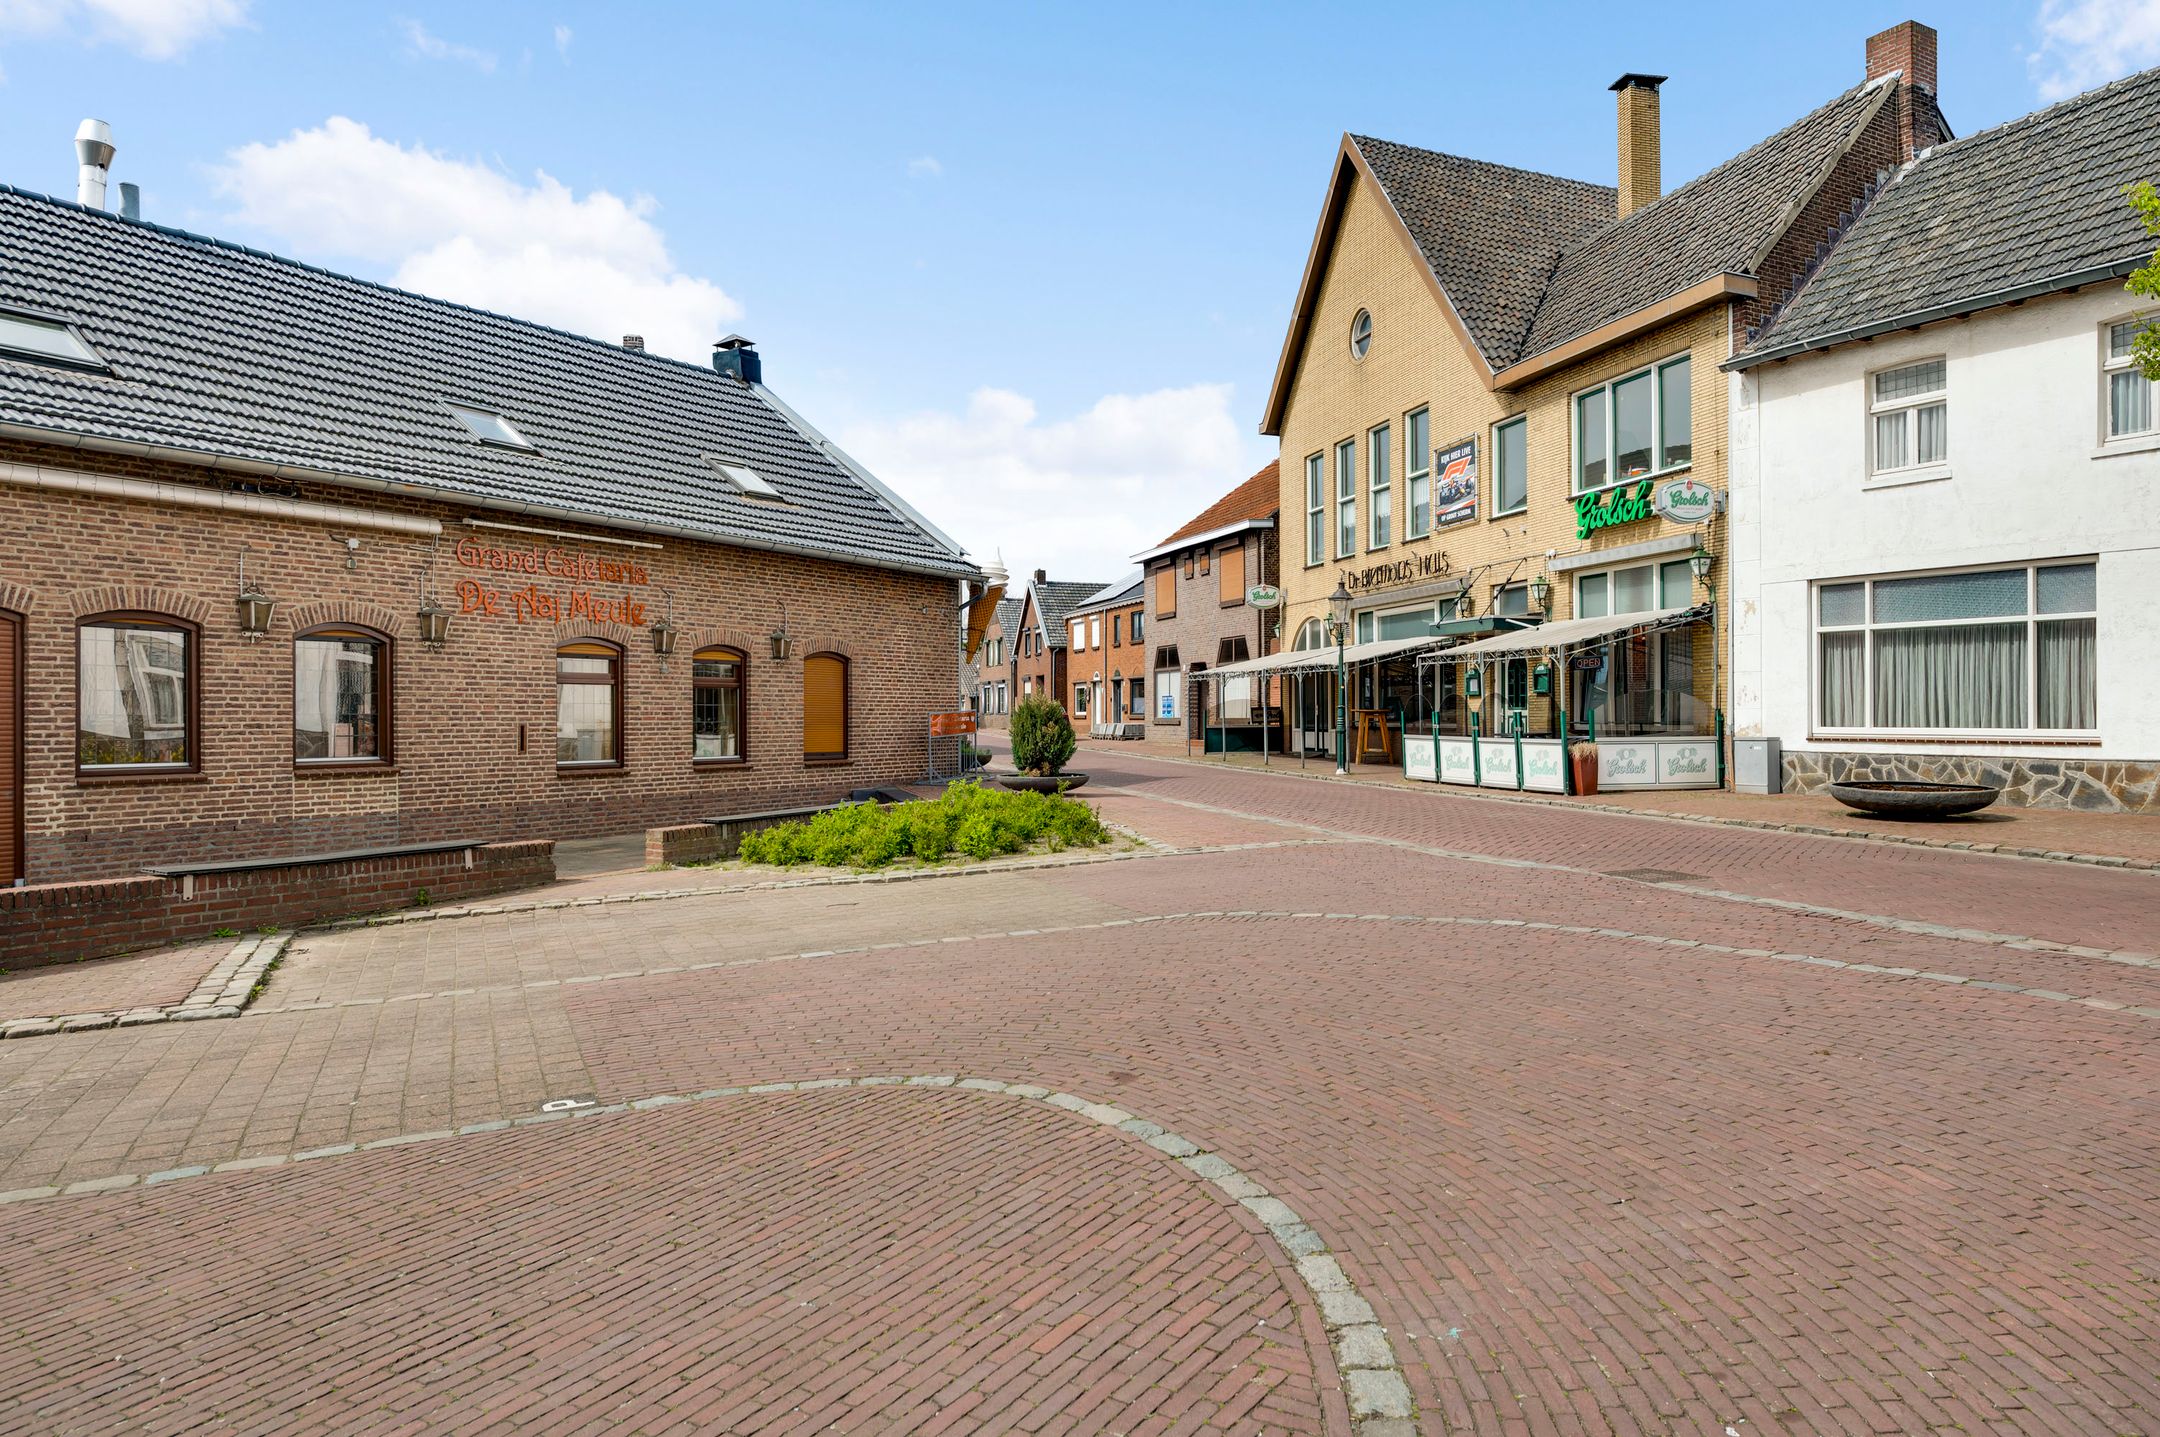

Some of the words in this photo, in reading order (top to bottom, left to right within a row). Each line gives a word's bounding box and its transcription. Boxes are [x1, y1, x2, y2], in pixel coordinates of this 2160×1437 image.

[1461, 446, 1472, 457] LIVE
[1670, 490, 1709, 508] Grolsch
[1575, 480, 1651, 540] Grolsch
[457, 536, 539, 574] Grand
[544, 547, 649, 585] Cafetaria
[456, 577, 502, 616] De
[511, 585, 560, 624] Aaj
[570, 590, 647, 627] Meule
[1252, 591, 1277, 601] Grolsch
[1576, 658, 1600, 668] OPEN
[1409, 752, 1431, 767] Grolsch
[1445, 755, 1470, 770] Grolsch
[1485, 757, 1512, 774] Grolsch
[1528, 759, 1558, 777] Grolsch
[1607, 759, 1647, 777] Grolsch
[1667, 758, 1707, 776] Grolsch
